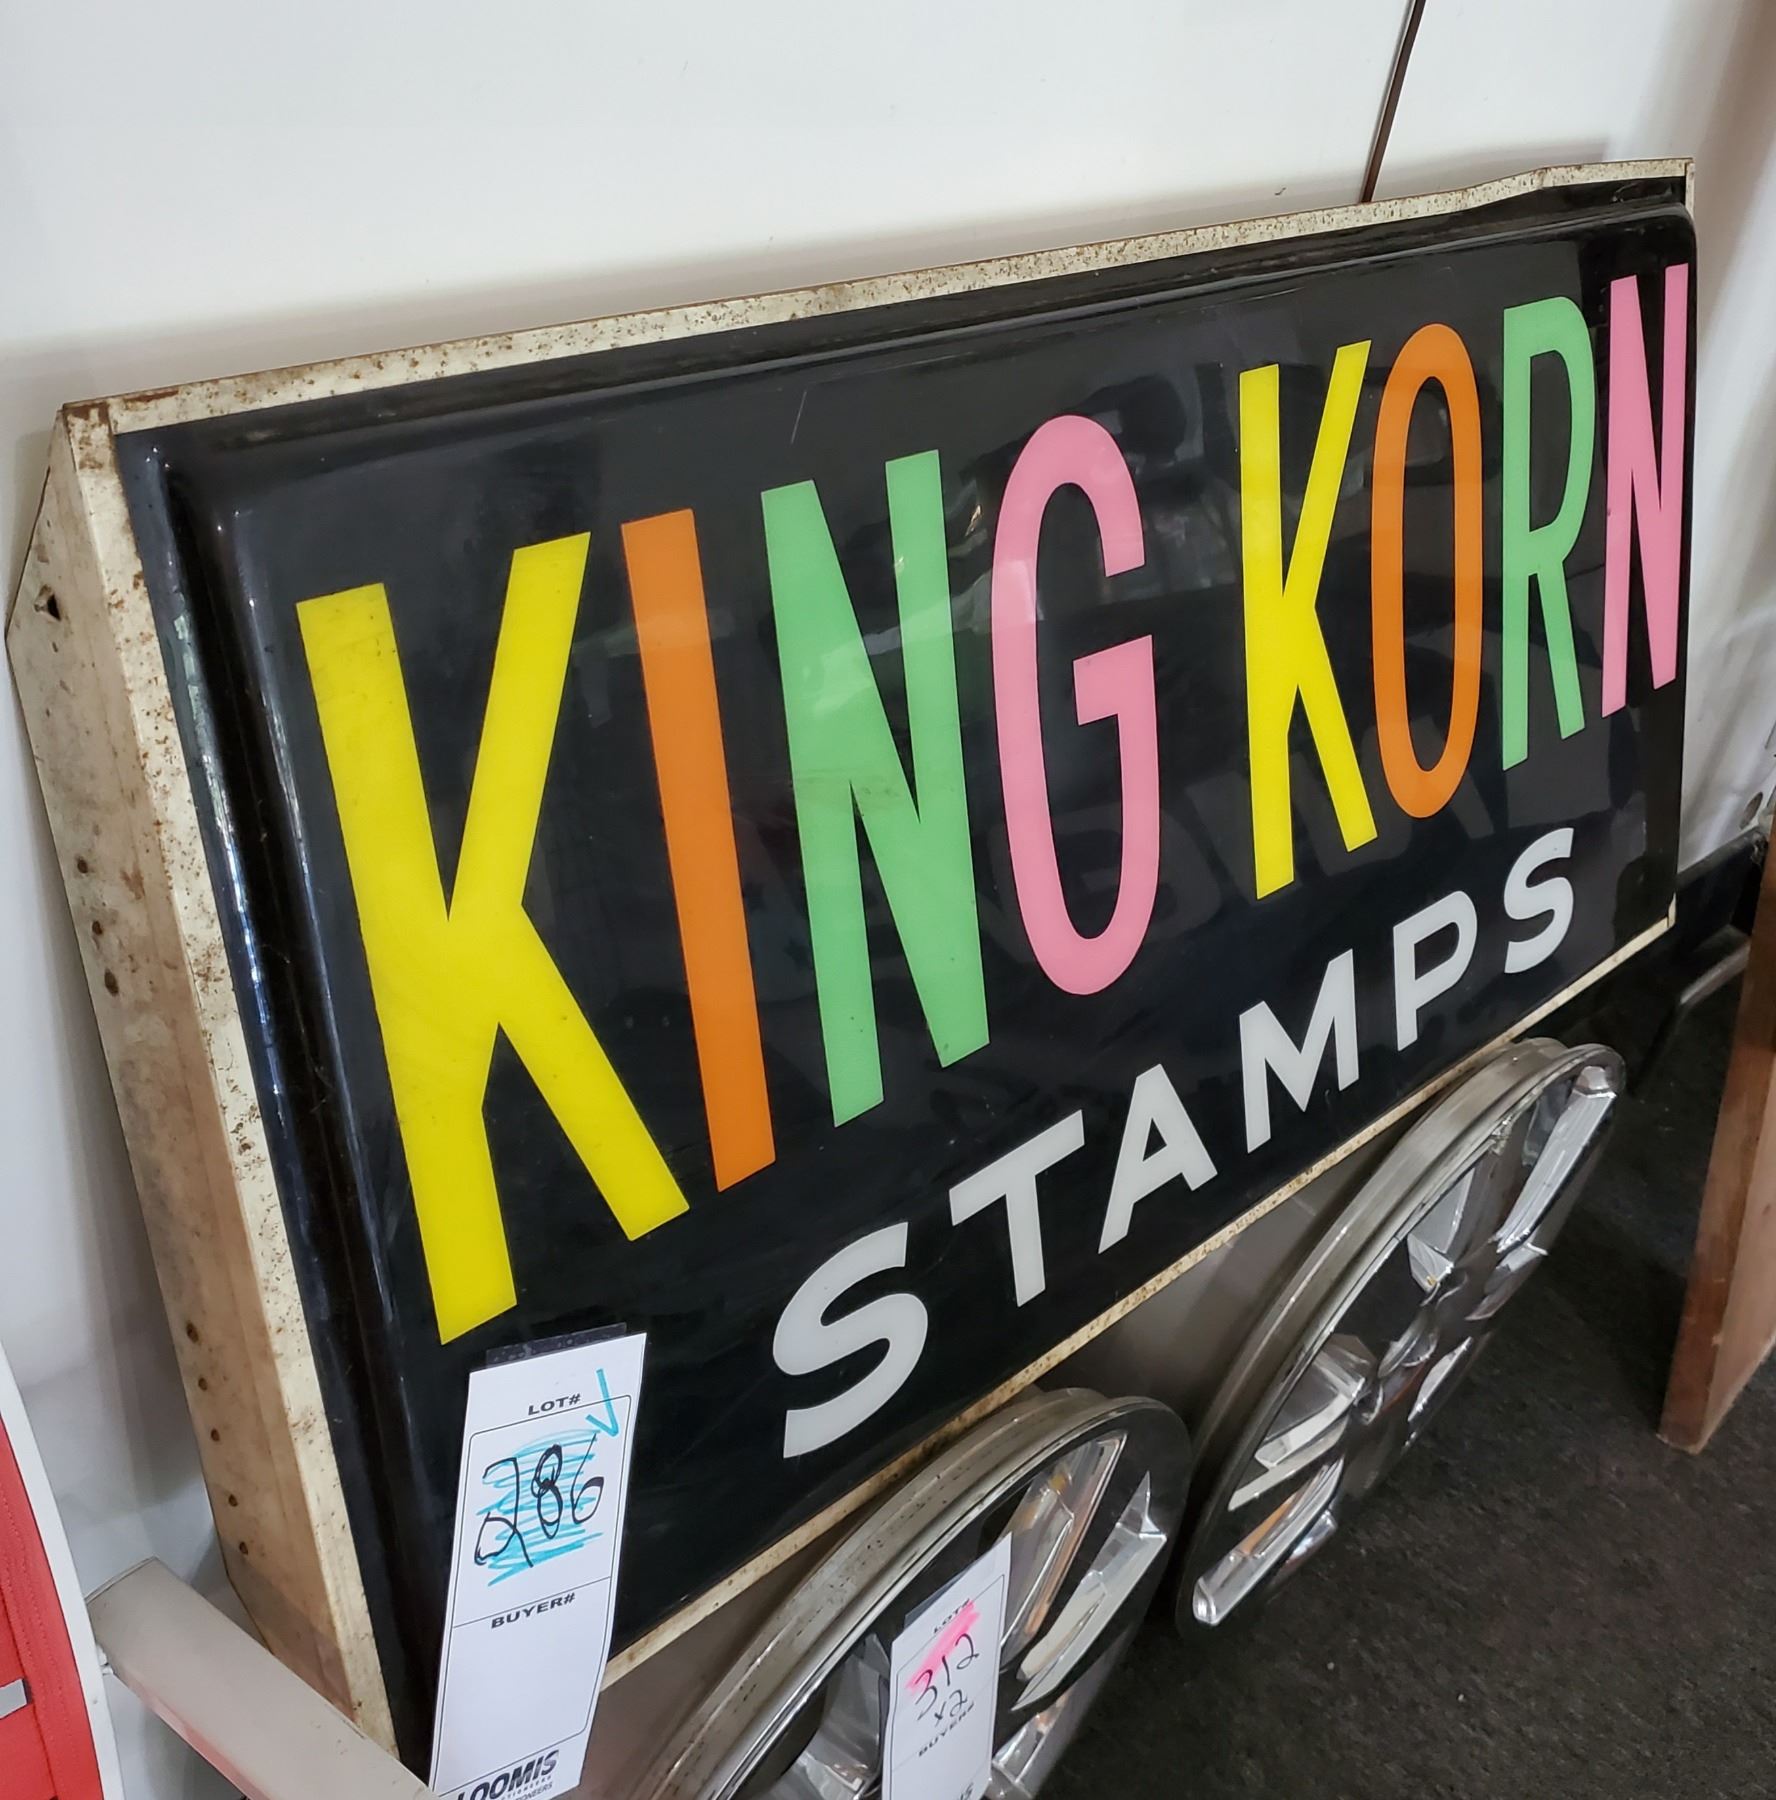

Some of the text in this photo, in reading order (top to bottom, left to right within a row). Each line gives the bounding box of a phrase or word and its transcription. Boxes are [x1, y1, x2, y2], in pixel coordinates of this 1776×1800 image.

[297, 263, 1688, 1344] KING KORN
[773, 827, 1574, 1458] STAMPS
[528, 1393, 581, 1415] LOT#
[474, 1433, 604, 1568] 286
[491, 1593, 575, 1629] BUYER#
[914, 1633, 979, 1720] 312
